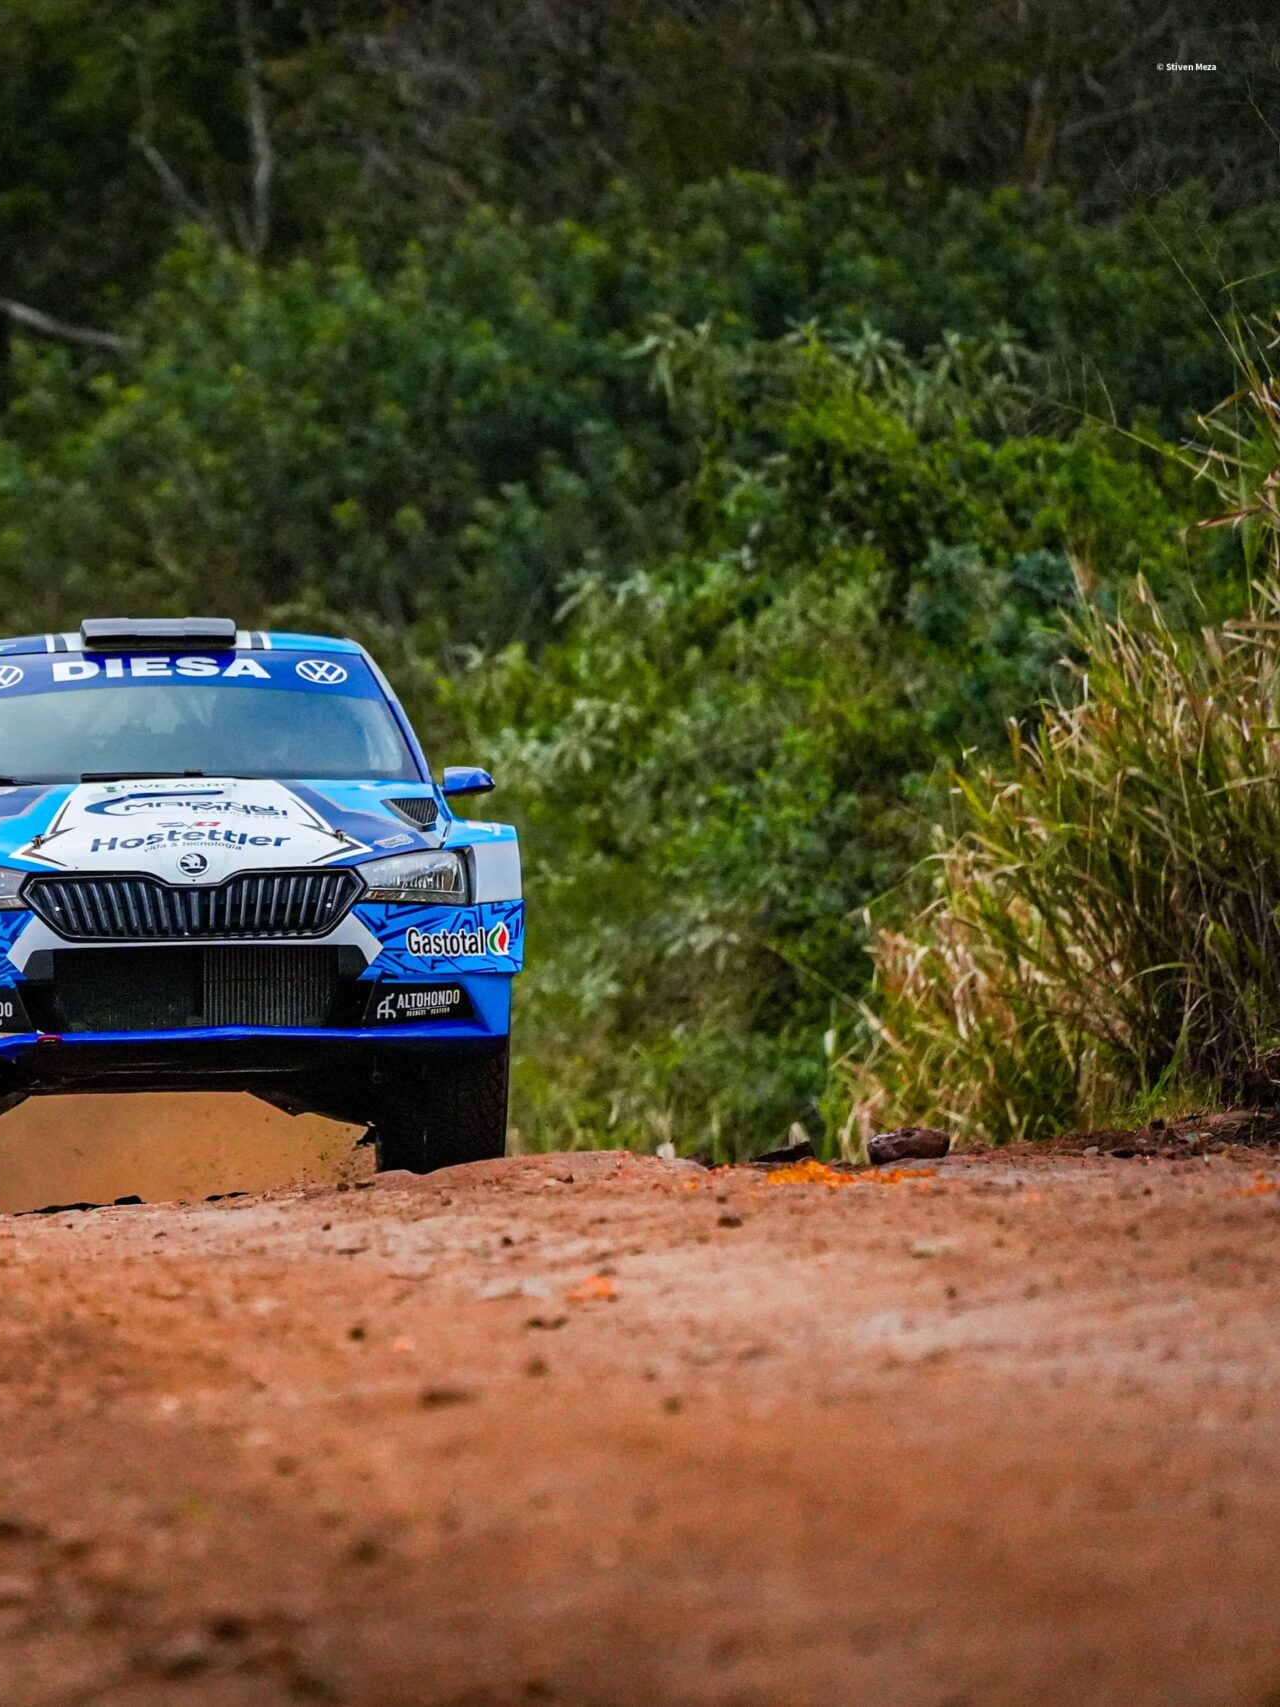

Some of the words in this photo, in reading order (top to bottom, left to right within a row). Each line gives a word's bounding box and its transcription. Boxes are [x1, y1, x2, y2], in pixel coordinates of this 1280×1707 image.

[52, 656, 271, 683] DIESA
[90, 829, 292, 852] Hostettler
[144, 842, 167, 853] vida
[408, 928, 486, 955] Gastotal
[397, 989, 461, 1009] ALTOHONDO
